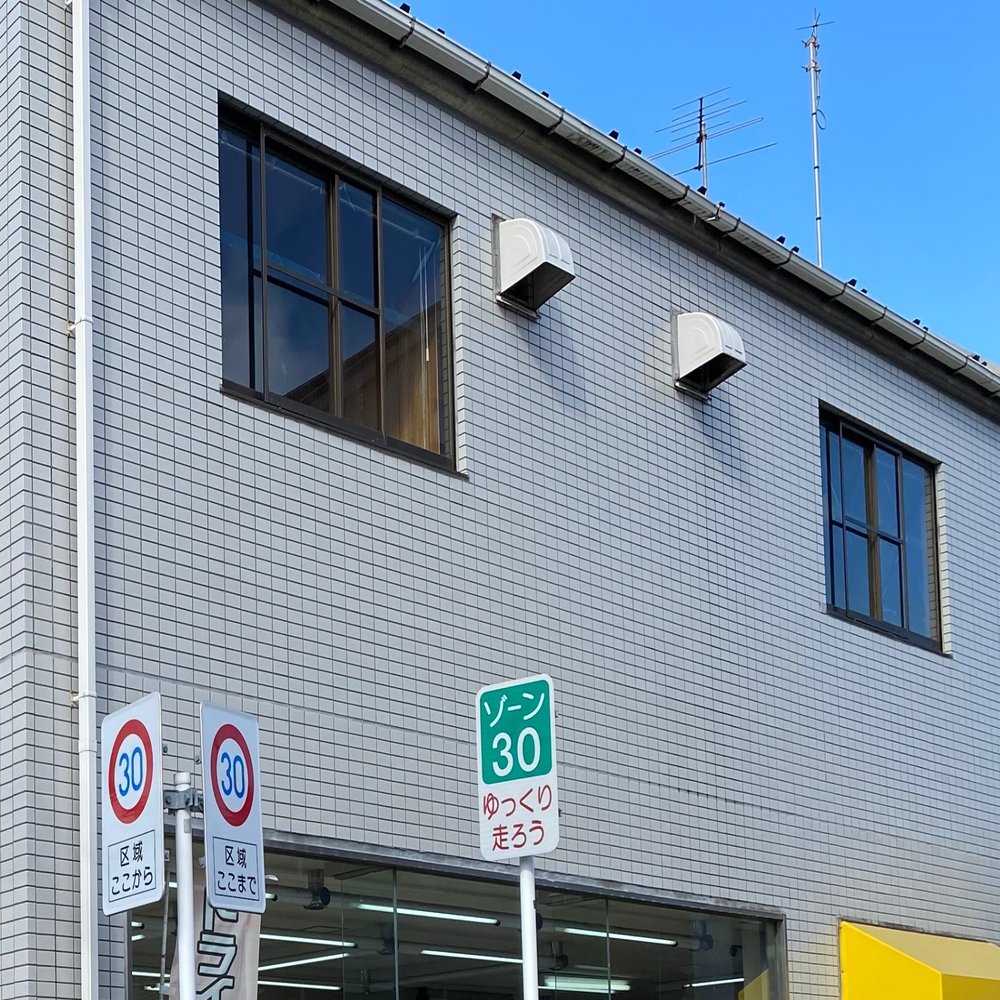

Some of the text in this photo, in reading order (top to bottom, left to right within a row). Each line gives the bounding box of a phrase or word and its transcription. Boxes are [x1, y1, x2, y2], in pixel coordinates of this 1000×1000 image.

[484, 692, 545, 728] ゾーン
[492, 726, 541, 777] 30
[119, 746, 143, 797] 30
[221, 752, 246, 799] 30
[483, 784, 552, 820] ゆっくり
[492, 820, 545, 851] 走ろう
[120, 840, 143, 867] 区域
[225, 845, 247, 868] 区域
[111, 866, 153, 895] ここから
[217, 871, 257, 895] ここまで
